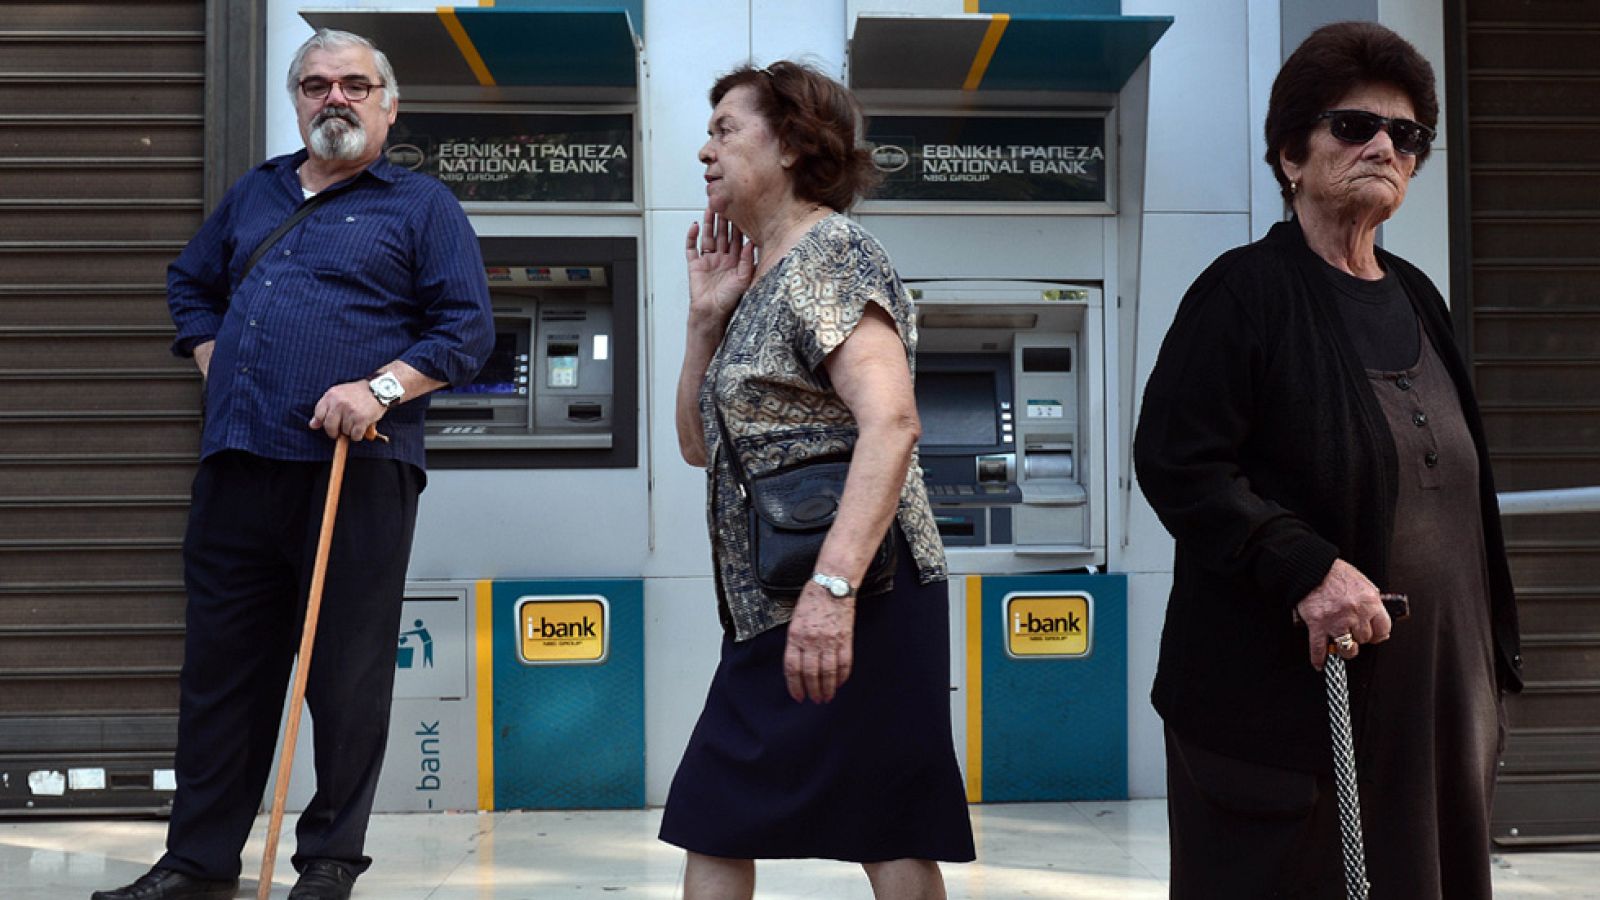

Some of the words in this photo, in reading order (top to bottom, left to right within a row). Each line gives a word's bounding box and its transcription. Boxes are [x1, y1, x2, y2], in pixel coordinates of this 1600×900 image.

[439, 143, 520, 158] ΕΘΝΙΚΗ
[526, 144, 627, 159] ΤΡΑΠΕΖΑ
[923, 144, 1001, 159] ΕΘΝΙΚΗ
[1007, 145, 1104, 160] ΤΡΑΠΕΖΑ
[439, 159, 544, 173] NATIONAL
[549, 159, 609, 173] BANK
[923, 159, 1024, 174] NATIONAL
[1029, 160, 1087, 174] BANK
[949, 174, 990, 182] GROUP
[528, 616, 597, 639] i-bank
[1014, 611, 1081, 634] i-bank
